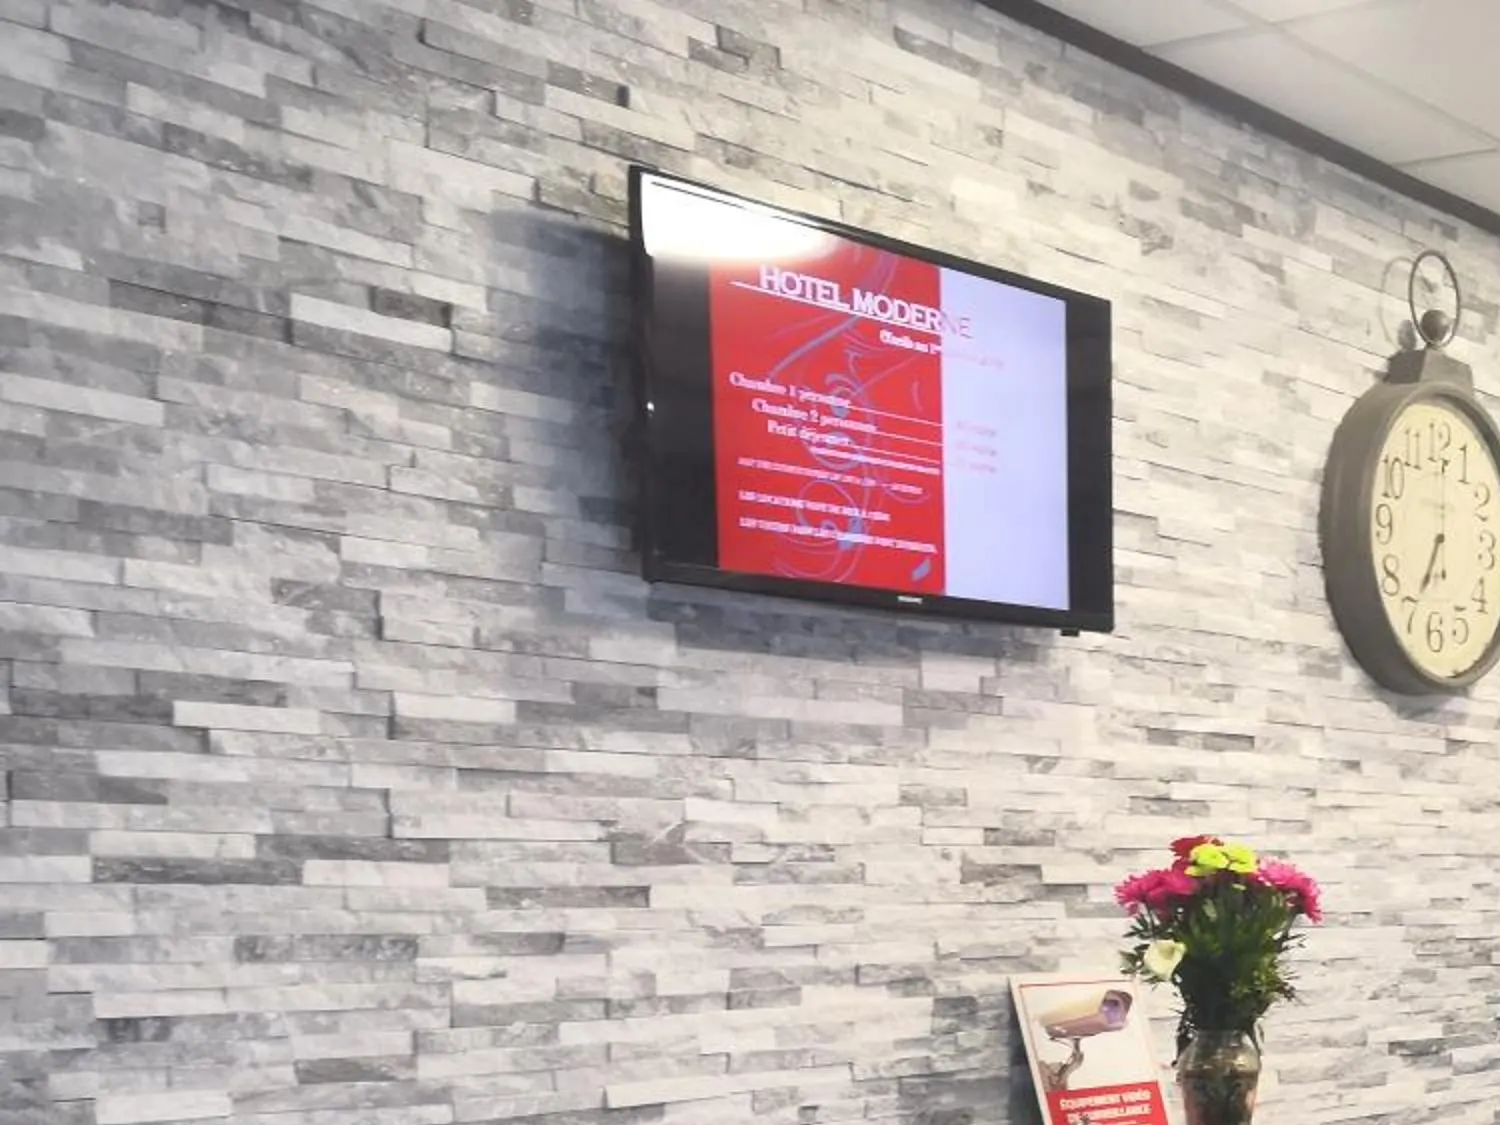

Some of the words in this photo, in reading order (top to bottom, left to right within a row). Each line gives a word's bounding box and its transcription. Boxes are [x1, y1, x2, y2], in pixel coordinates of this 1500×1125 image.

[759, 264, 850, 308] HOTEL
[852, 287, 973, 339] MODERNE
[1404, 428, 1422, 470] 11
[1427, 422, 1451, 465] 12
[1457, 443, 1471, 484] 1
[1381, 454, 1405, 500] 10
[1472, 482, 1490, 522] 2
[1375, 503, 1393, 545] 9
[1478, 529, 1496, 570] 3
[1382, 554, 1400, 597] 8
[1470, 576, 1488, 615] 4
[1401, 595, 1418, 634] 7
[1426, 611, 1443, 653] 6
[1452, 605, 1469, 645] 5
